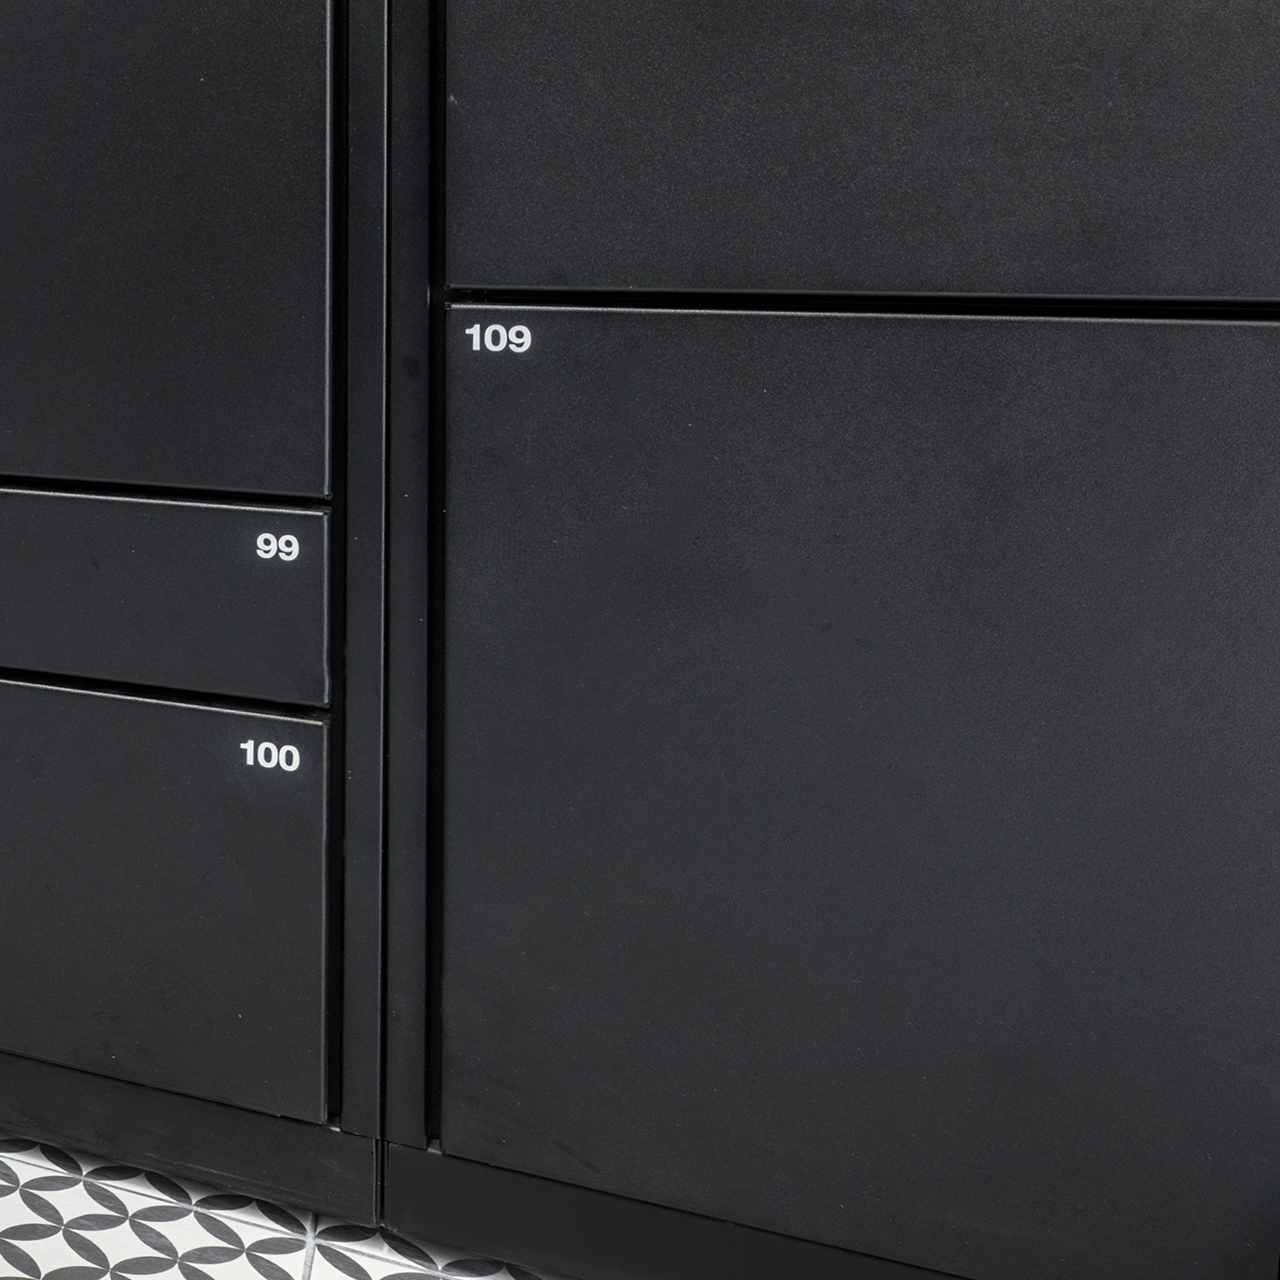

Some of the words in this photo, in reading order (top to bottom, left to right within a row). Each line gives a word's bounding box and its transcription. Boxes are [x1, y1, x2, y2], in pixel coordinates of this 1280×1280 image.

[464, 323, 533, 354] 109
[255, 532, 300, 562] 99
[239, 739, 301, 773] 100
